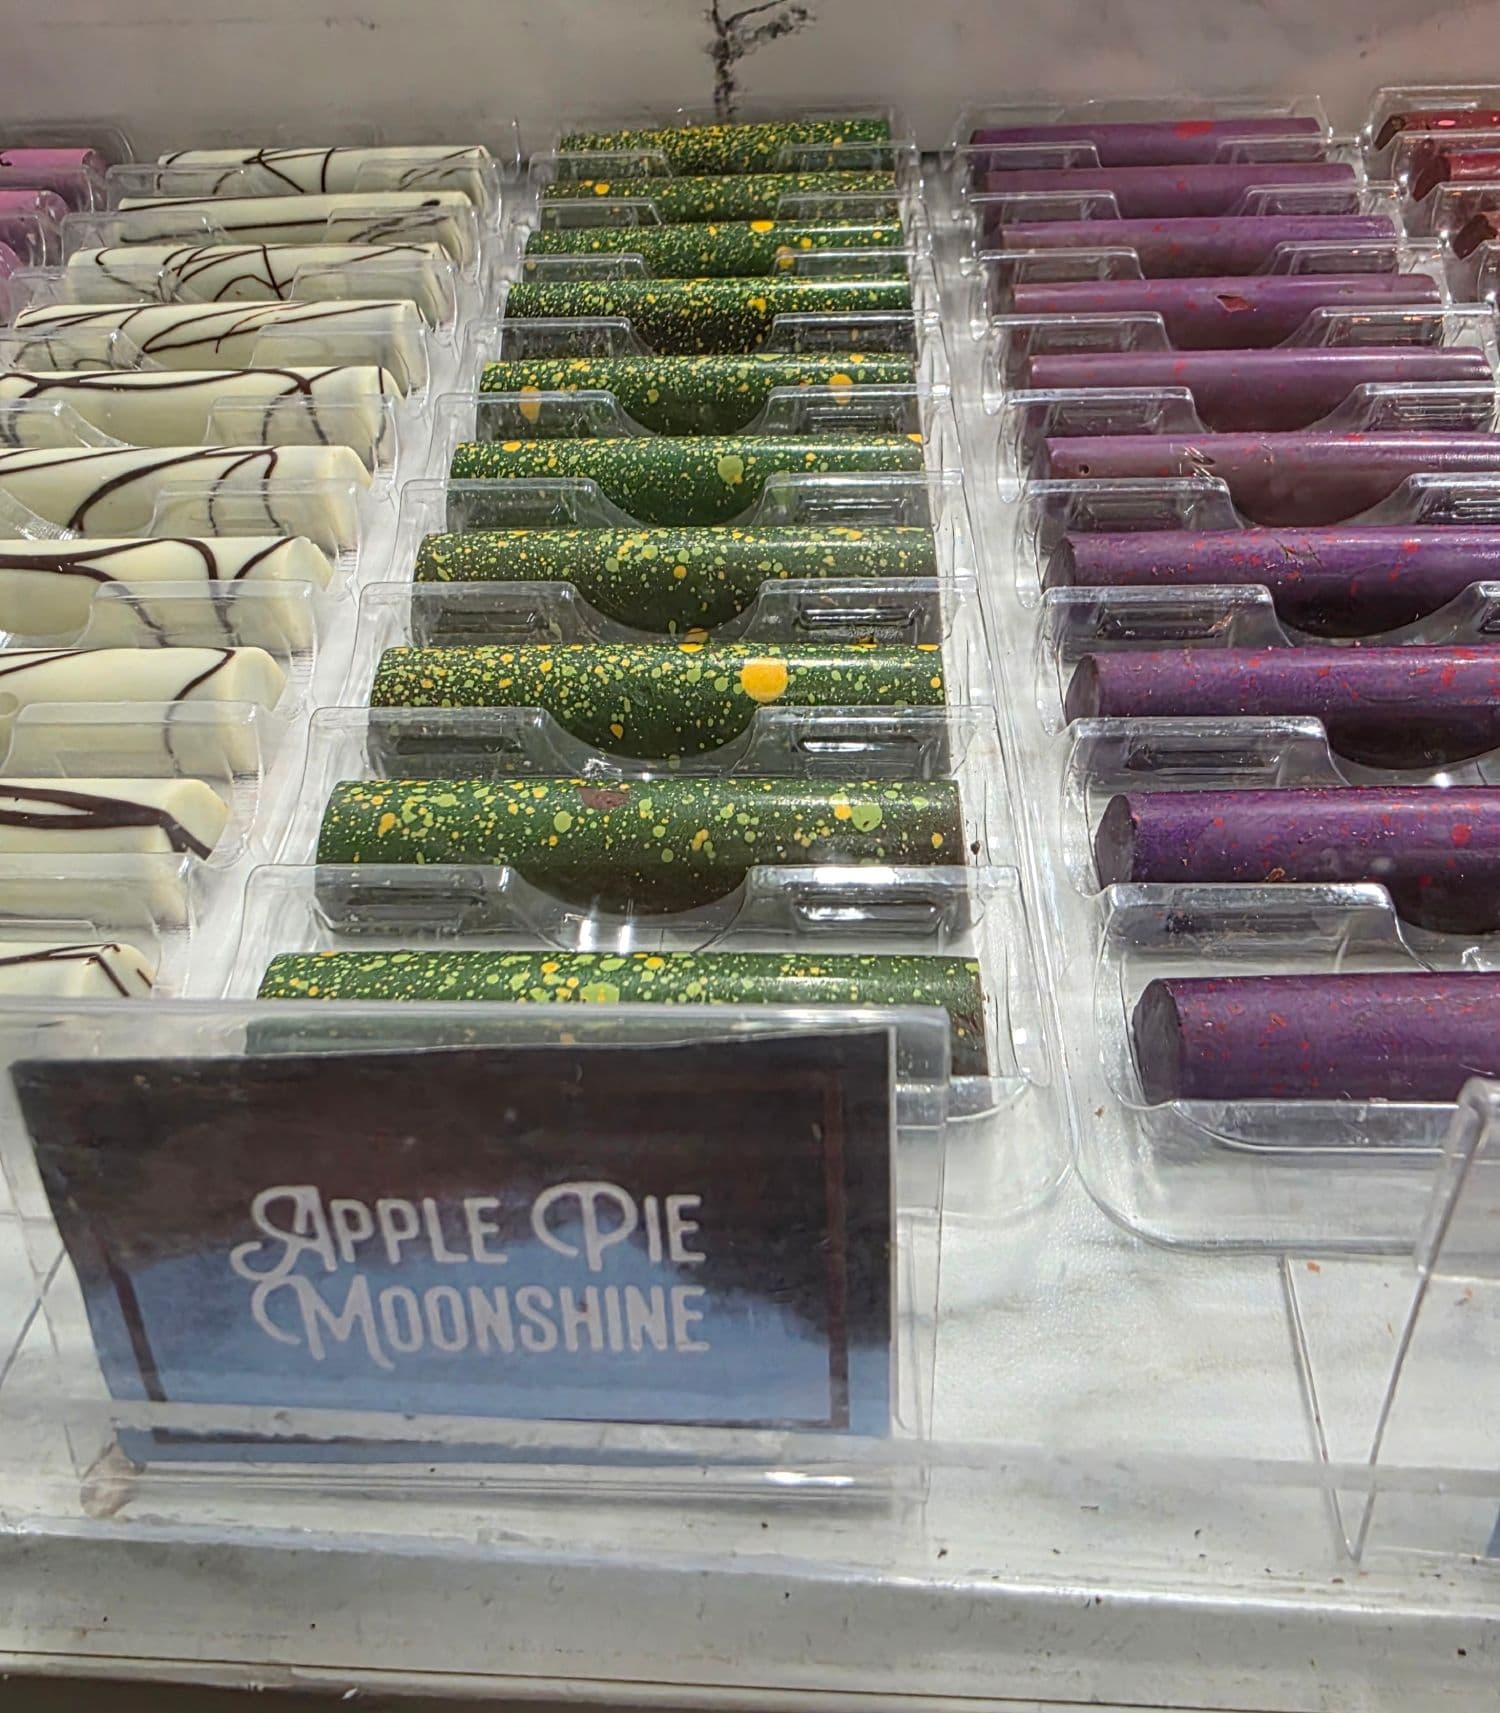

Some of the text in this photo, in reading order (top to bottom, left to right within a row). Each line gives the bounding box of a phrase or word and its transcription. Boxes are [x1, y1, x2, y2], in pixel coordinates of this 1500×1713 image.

[229, 1181, 706, 1280] APPLE PIE
[251, 1274, 711, 1371] MOONSHINE
